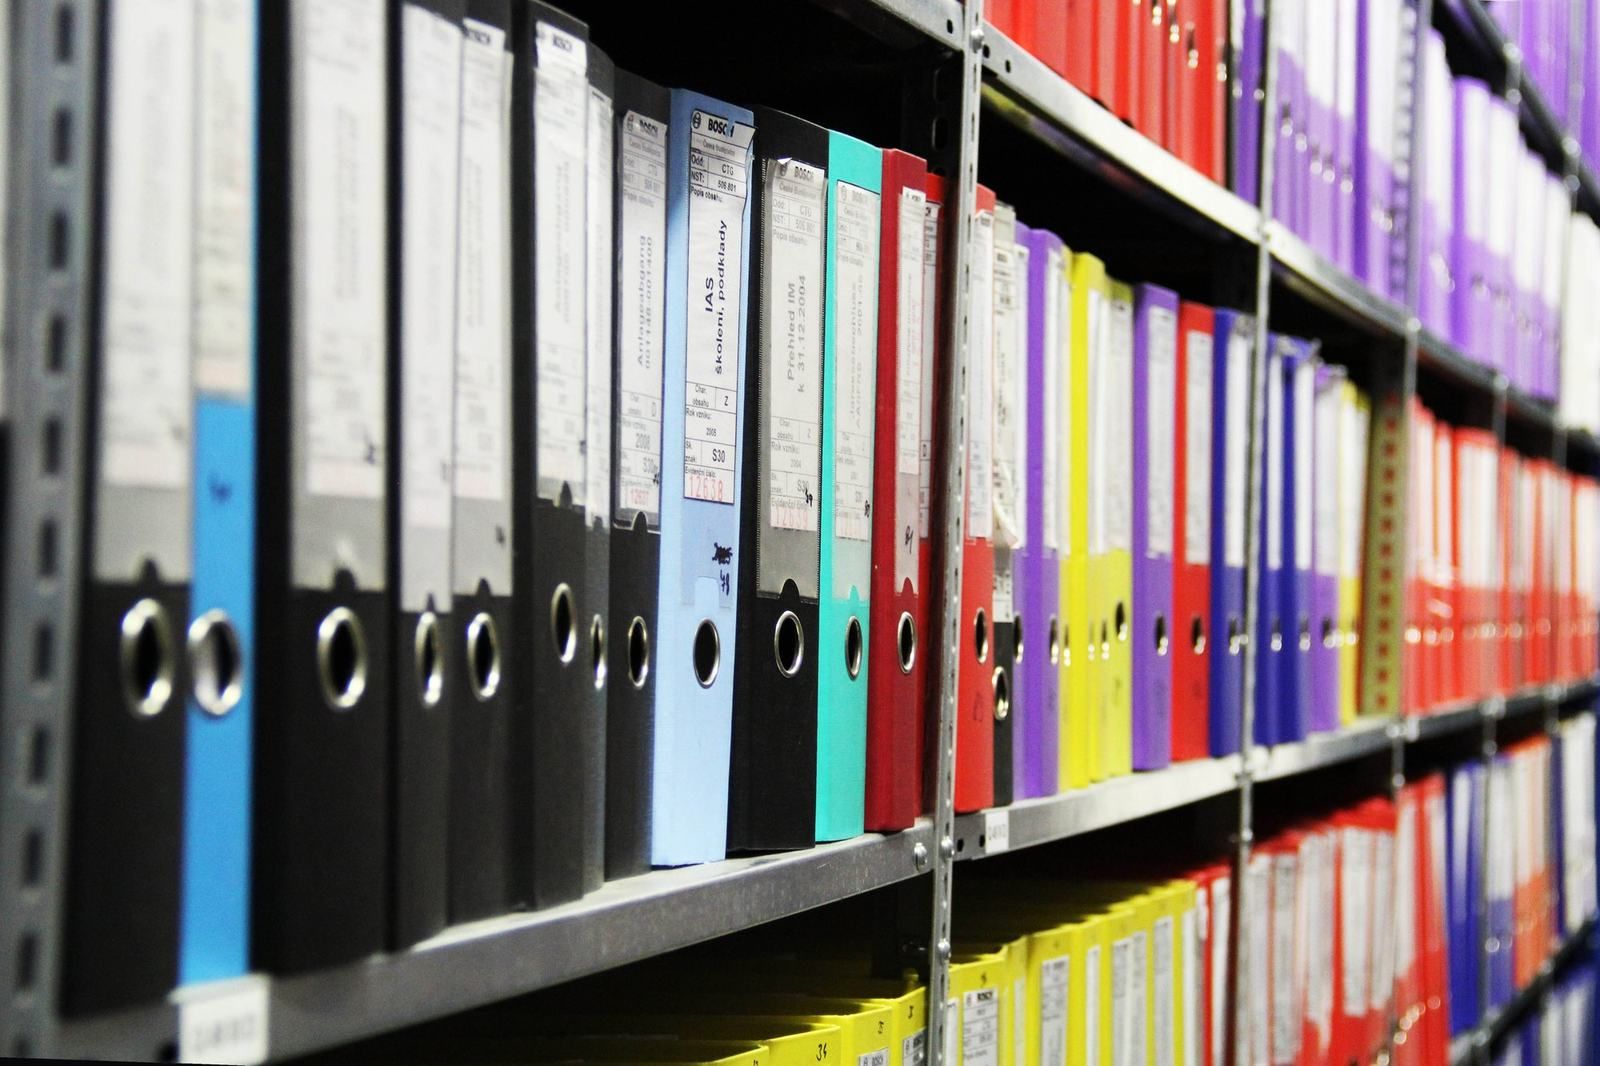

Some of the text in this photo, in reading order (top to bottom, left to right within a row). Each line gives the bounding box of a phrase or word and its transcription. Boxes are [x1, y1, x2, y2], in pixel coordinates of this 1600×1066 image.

[721, 163, 734, 176] CTG
[718, 219, 728, 301] podklady
[705, 276, 714, 313] IAS
[787, 282, 796, 304] IM
[712, 448, 726, 463] S30
[688, 475, 724, 502] 12638
